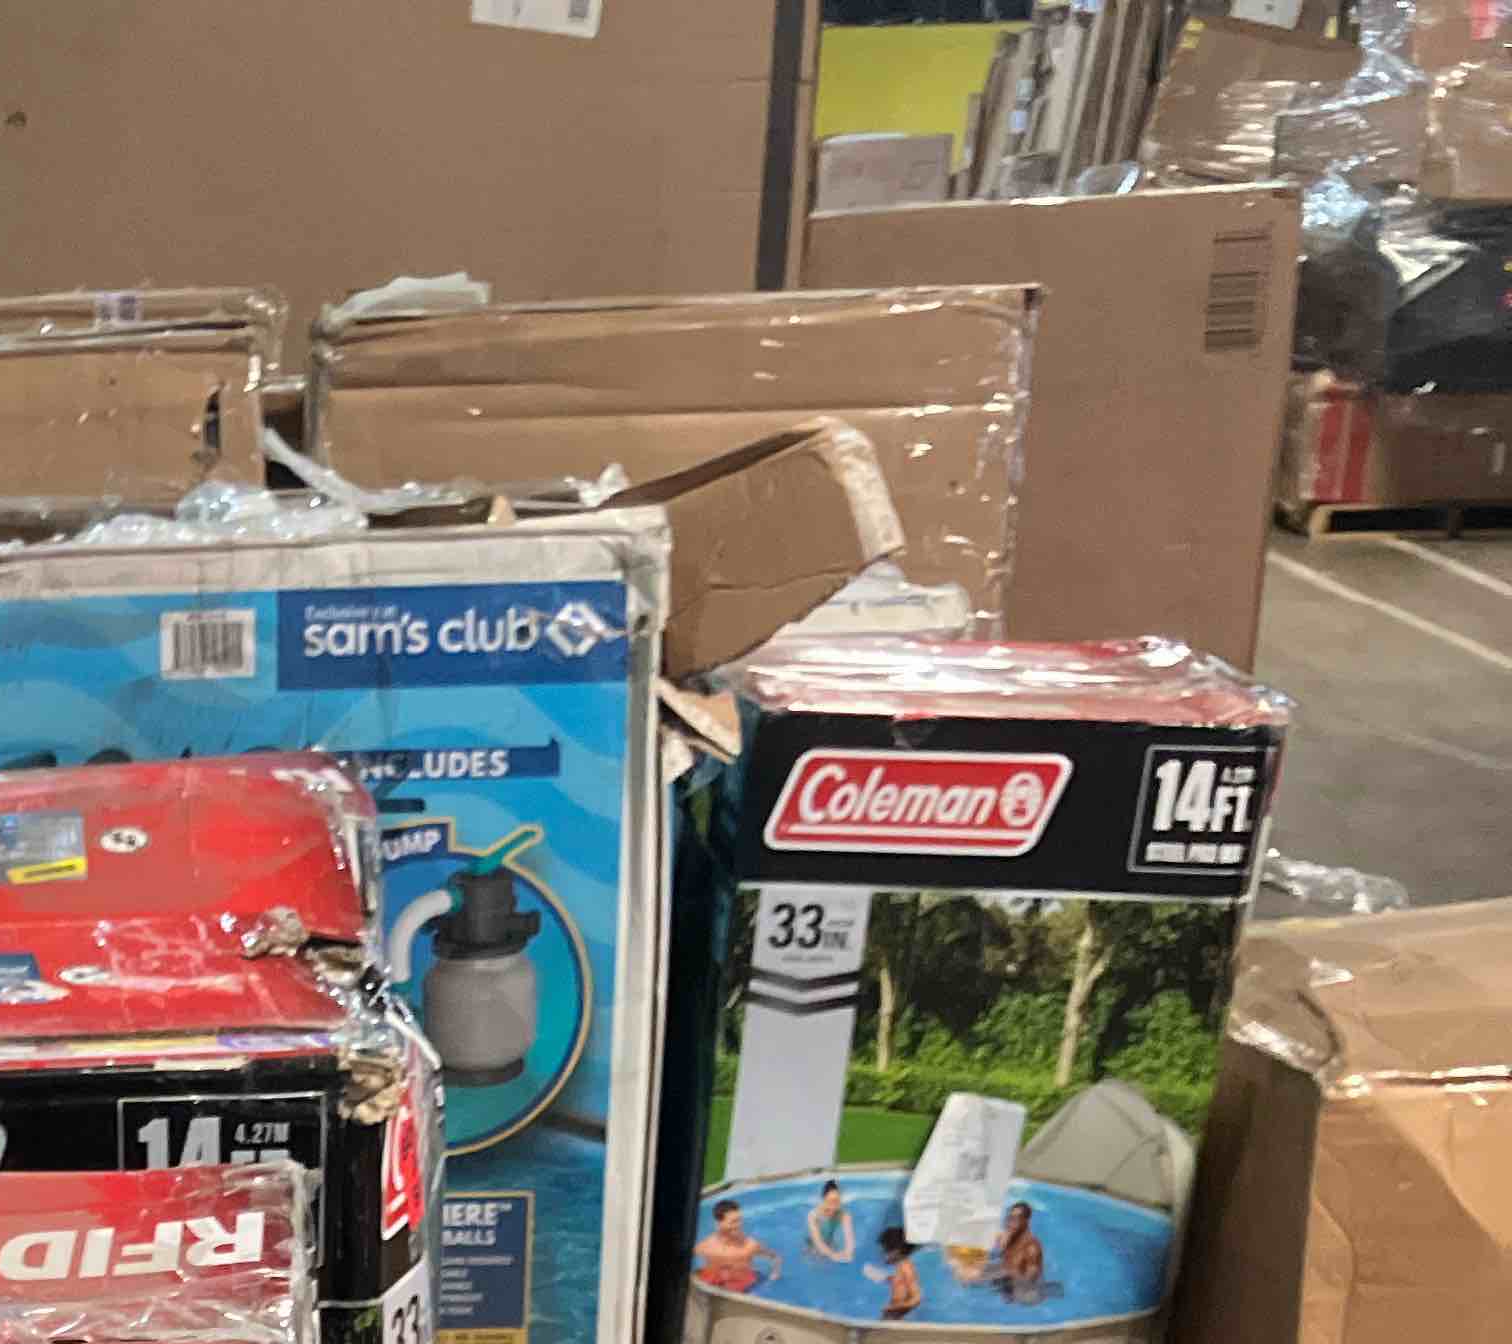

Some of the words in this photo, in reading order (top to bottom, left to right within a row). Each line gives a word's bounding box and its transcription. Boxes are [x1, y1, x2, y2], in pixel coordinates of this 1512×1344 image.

[303, 613, 430, 658] sam's
[438, 607, 538, 653] club
[798, 764, 1000, 825] Coleman
[1152, 759, 1217, 832] 14
[768, 902, 825, 950] 33
